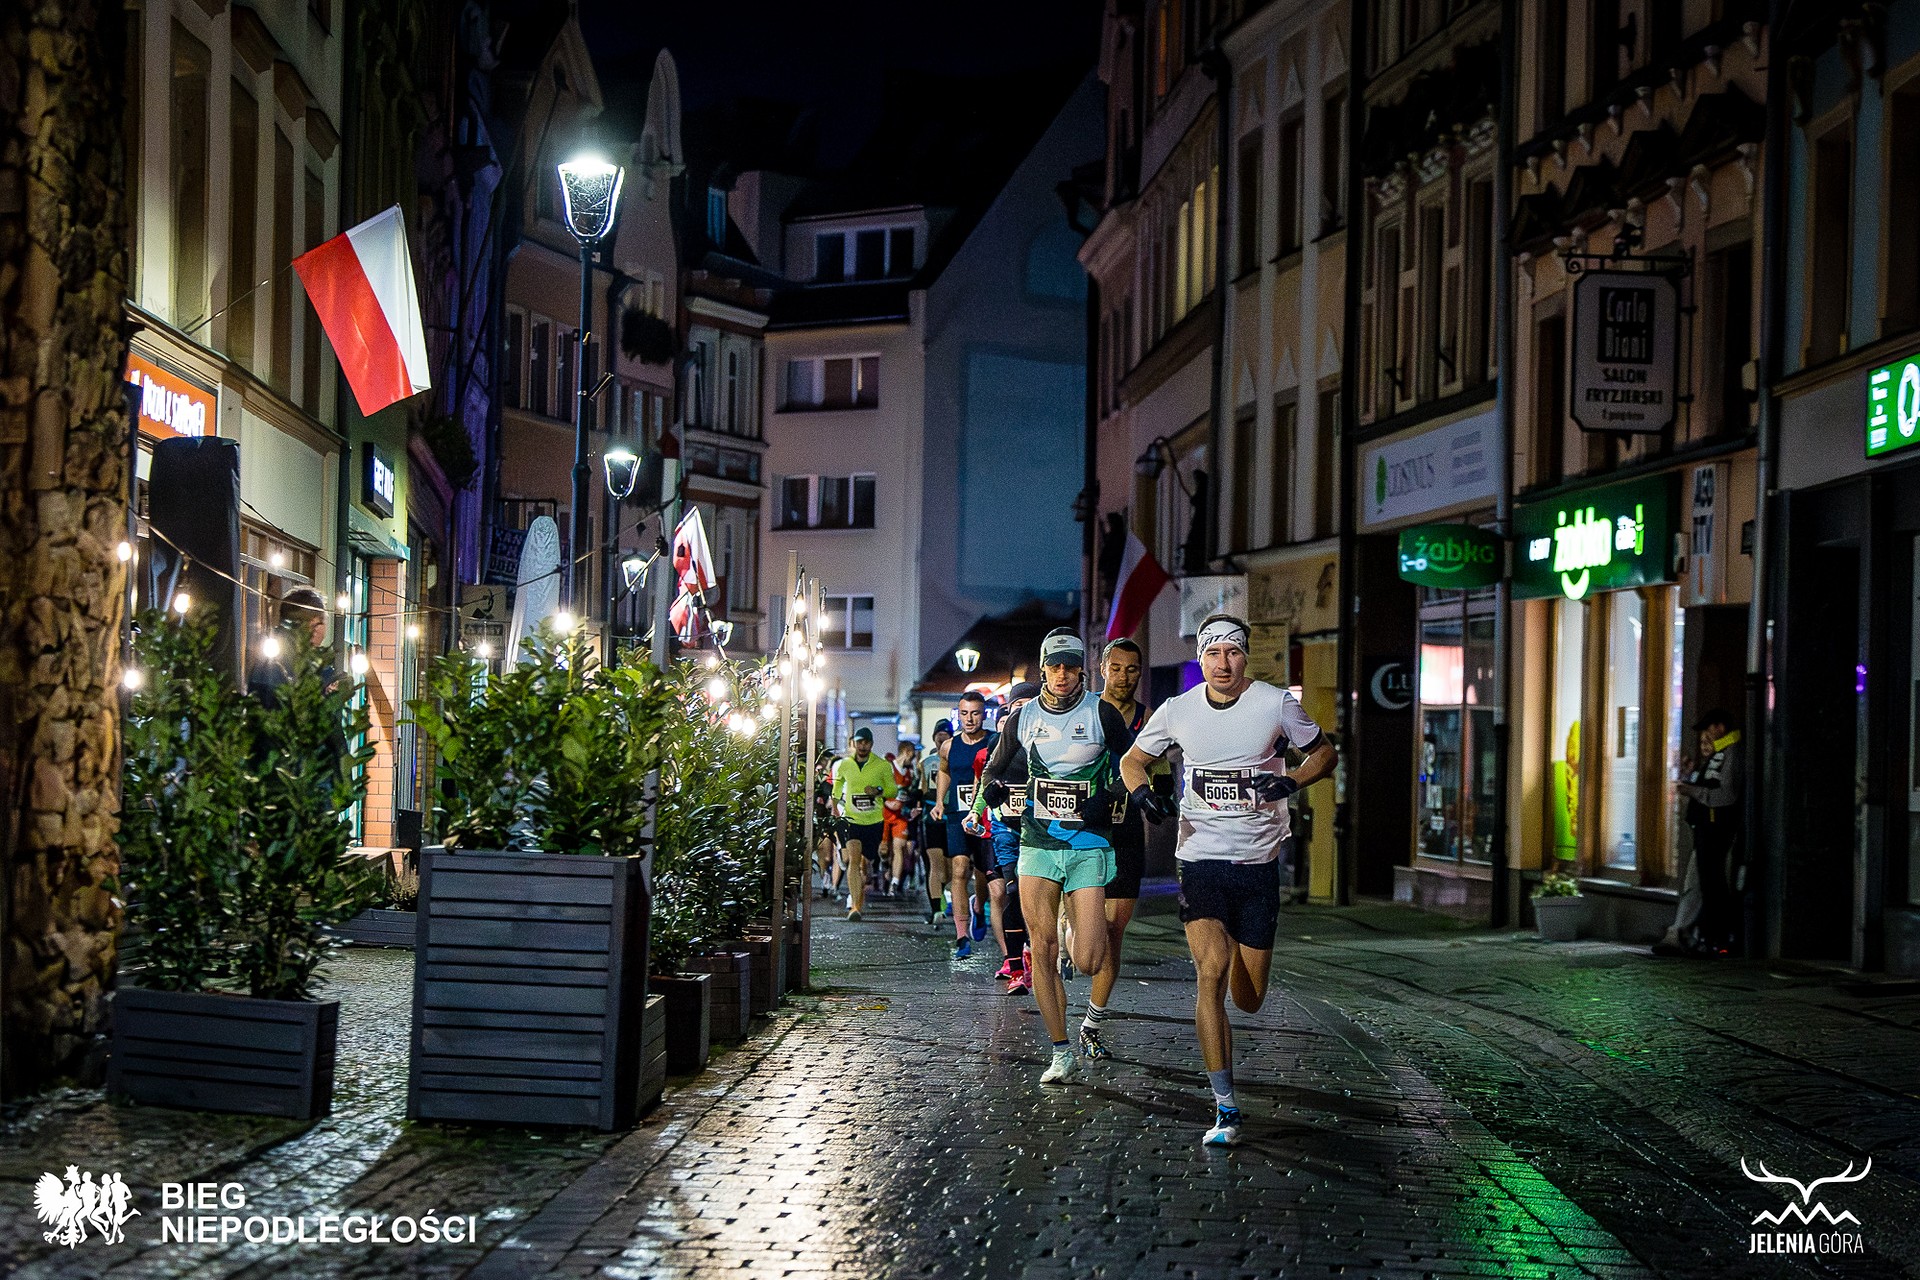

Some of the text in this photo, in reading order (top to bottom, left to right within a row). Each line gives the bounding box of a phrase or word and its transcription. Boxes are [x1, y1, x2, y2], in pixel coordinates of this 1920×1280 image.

[1602, 367, 1648, 383] SALON
[1585, 387, 1663, 404] FRYZJERSKI
[1415, 536, 1497, 565] żabka
[1206, 785, 1237, 801] 5065
[1048, 796, 1075, 810] 5036
